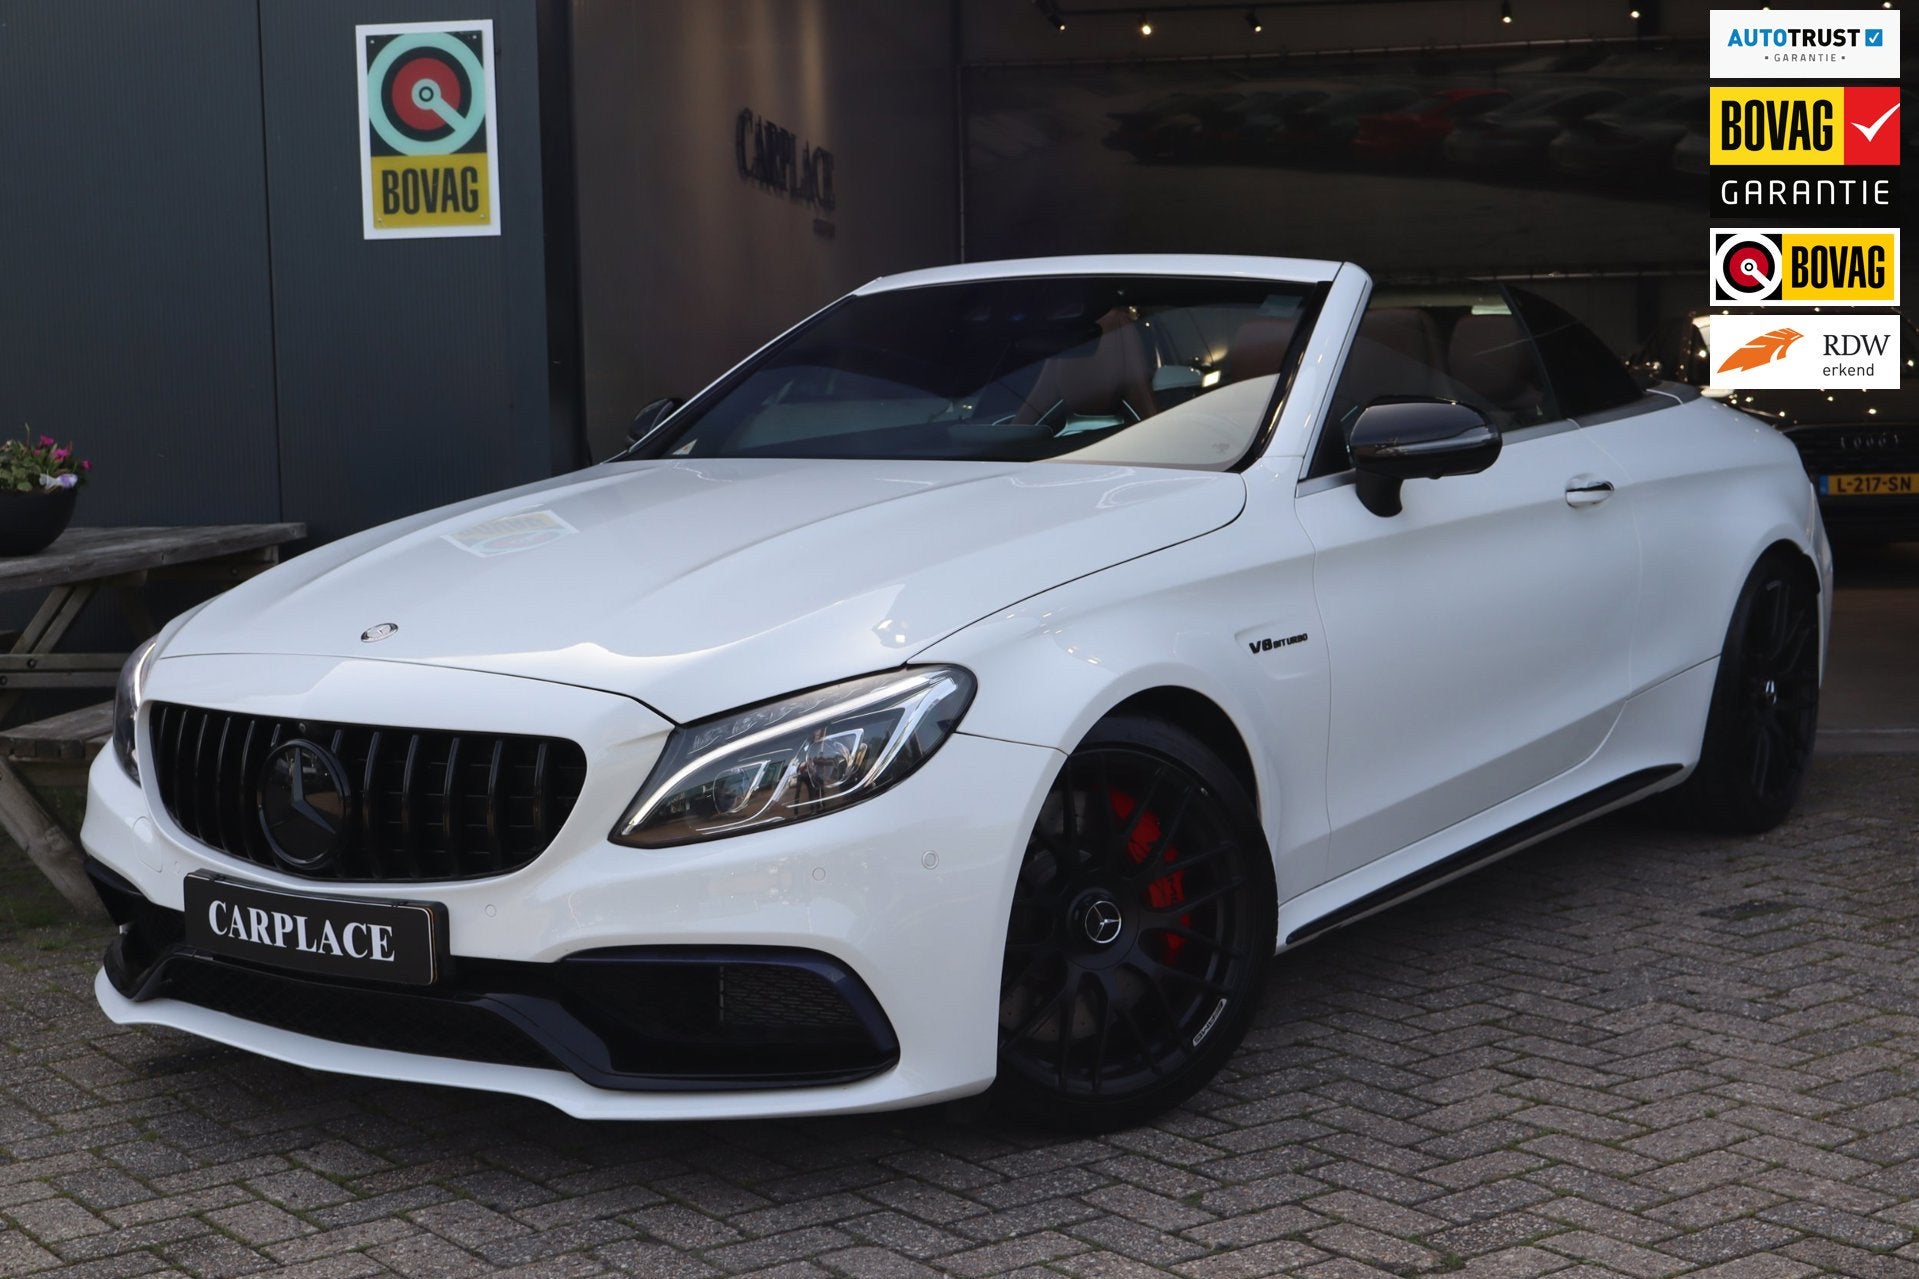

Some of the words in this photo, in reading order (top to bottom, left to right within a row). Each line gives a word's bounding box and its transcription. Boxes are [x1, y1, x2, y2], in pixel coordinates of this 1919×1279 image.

[381, 166, 479, 215] BOVAG
[1837, 476, 1912, 493] L-217-SN
[207, 899, 396, 962] CARPLACE
